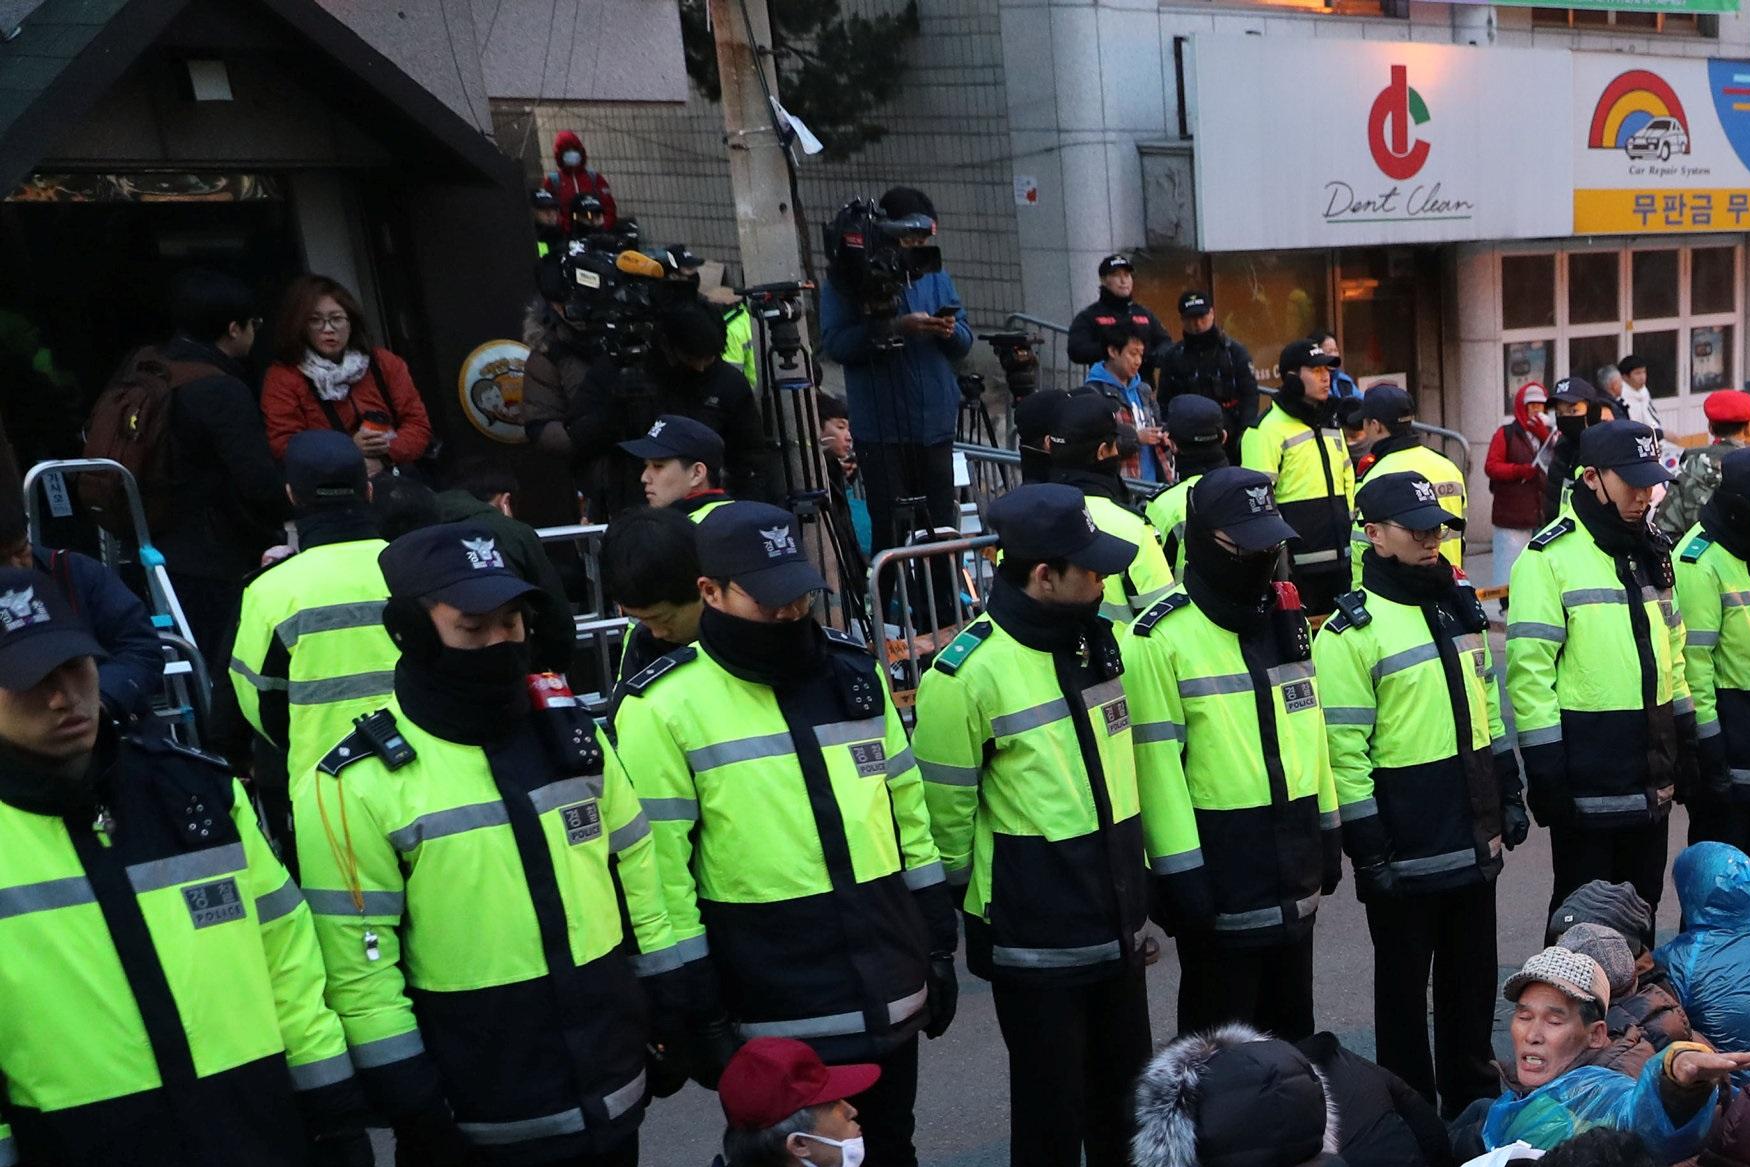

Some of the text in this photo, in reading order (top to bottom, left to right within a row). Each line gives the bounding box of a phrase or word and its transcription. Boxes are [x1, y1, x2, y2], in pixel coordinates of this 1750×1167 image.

[1628, 165, 1711, 178] Car Repair System
[1323, 181, 1474, 218] Dent Clean
[1633, 194, 1713, 225] 무판금
[196, 905, 242, 924] POLICE
